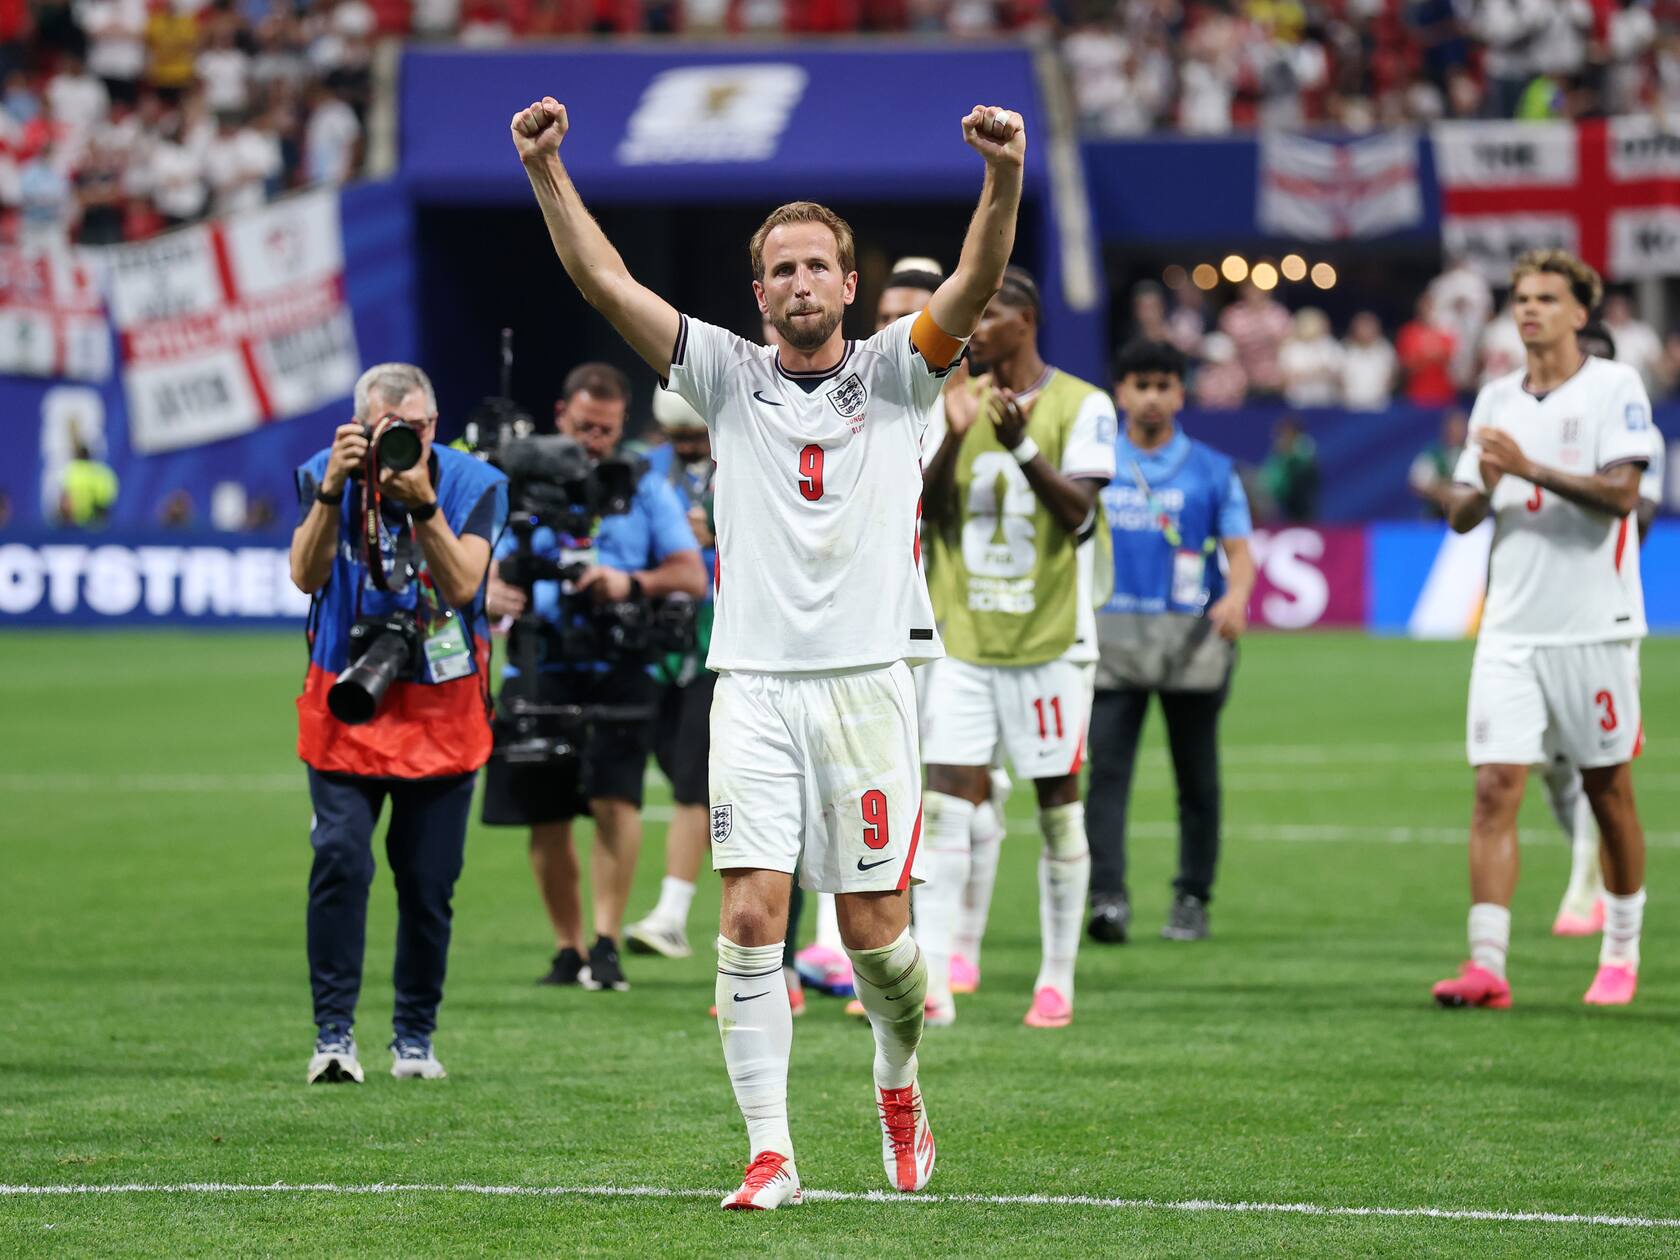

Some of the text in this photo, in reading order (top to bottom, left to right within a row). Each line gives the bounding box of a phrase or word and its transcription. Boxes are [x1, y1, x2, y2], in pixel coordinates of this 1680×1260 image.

[799, 444, 825, 501] 9
[1034, 697, 1063, 739] 11
[1595, 689, 1618, 732] 3
[861, 789, 889, 850] 9
